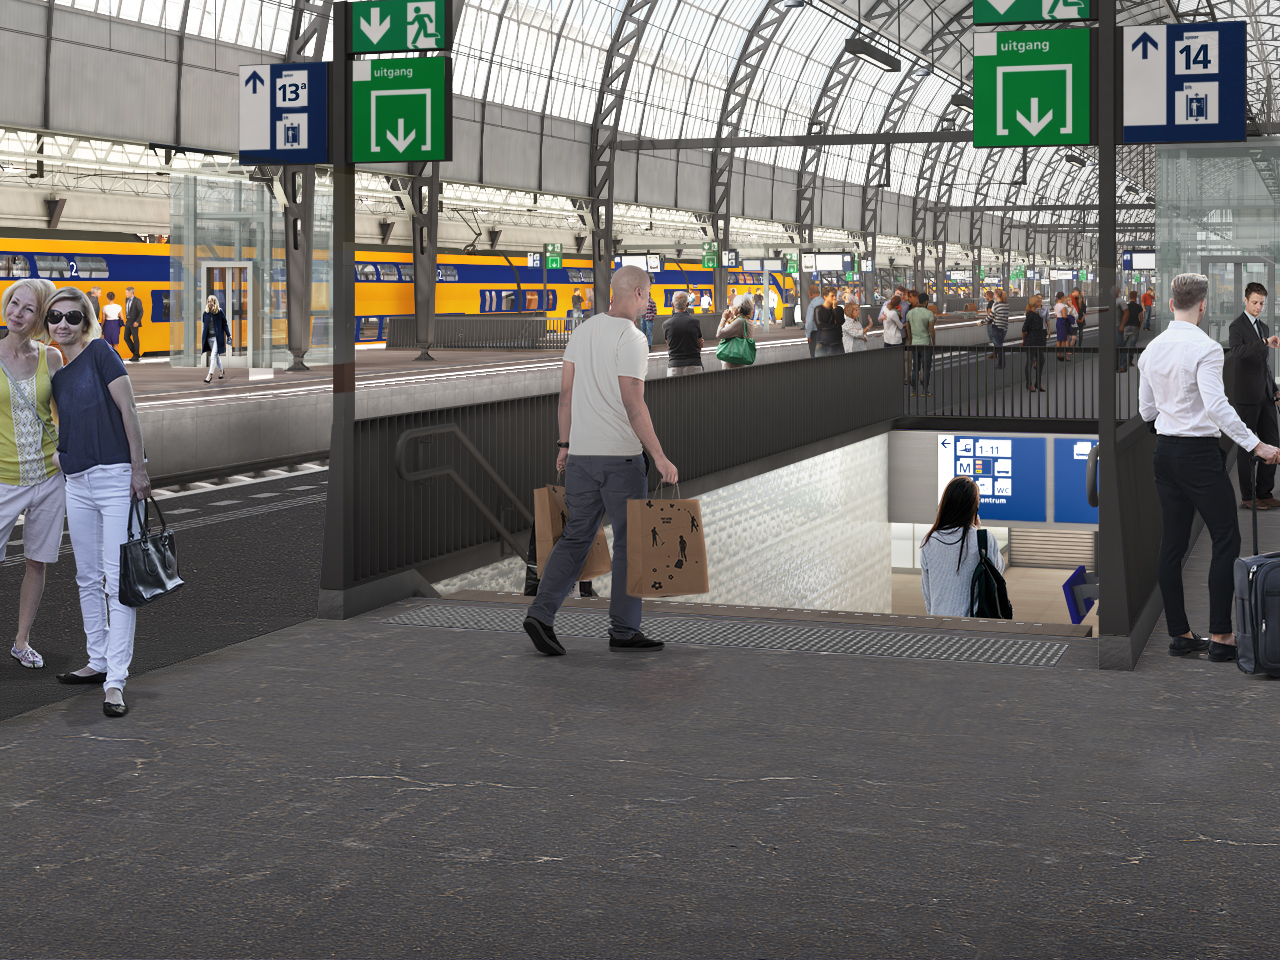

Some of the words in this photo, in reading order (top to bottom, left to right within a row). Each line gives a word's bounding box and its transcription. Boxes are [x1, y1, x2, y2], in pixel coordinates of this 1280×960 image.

[1001, 40, 1050, 53] uitgang
[1179, 44, 1211, 70] 14
[374, 67, 413, 79] uitgang
[70, 262, 79, 276] 2
[959, 463, 971, 474] M
